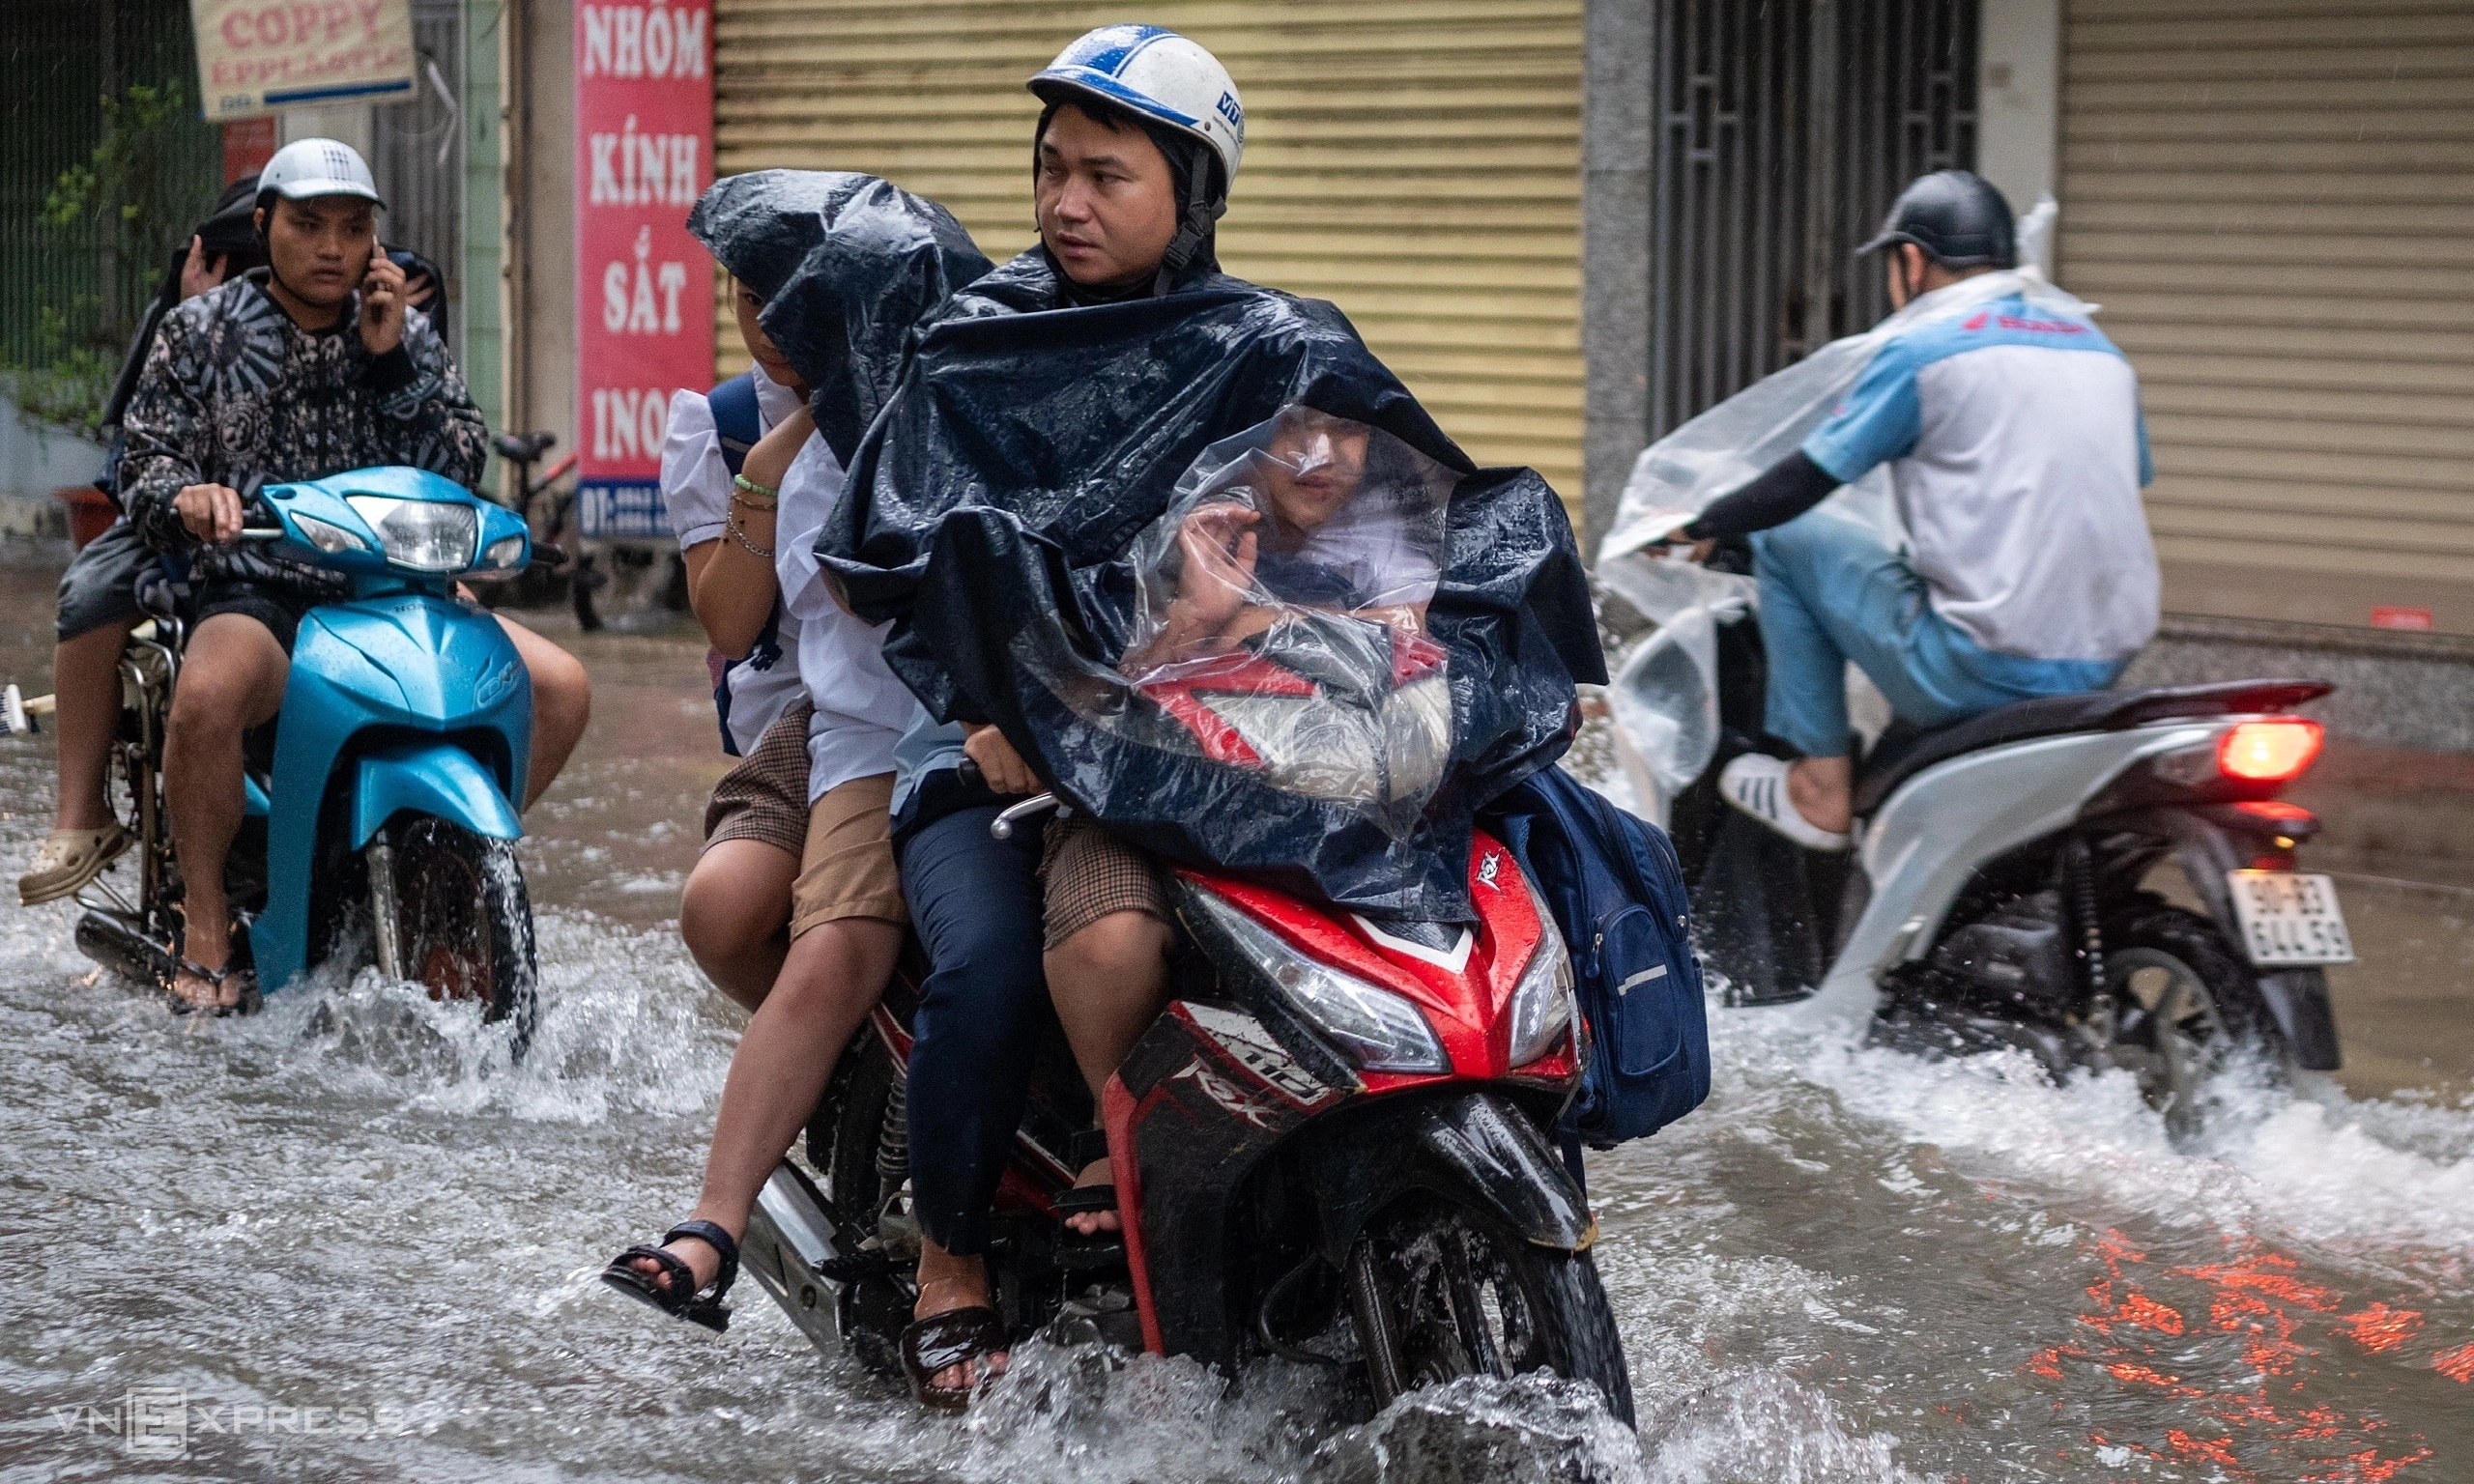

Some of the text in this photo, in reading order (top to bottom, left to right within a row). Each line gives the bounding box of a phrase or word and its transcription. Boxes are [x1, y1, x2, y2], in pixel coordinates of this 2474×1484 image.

[221, 1, 383, 49] COPPY
[583, 0, 707, 77] NHÔM
[590, 113, 699, 206] KÍNH
[603, 224, 686, 333] SẮT
[592, 388, 673, 461] INO
